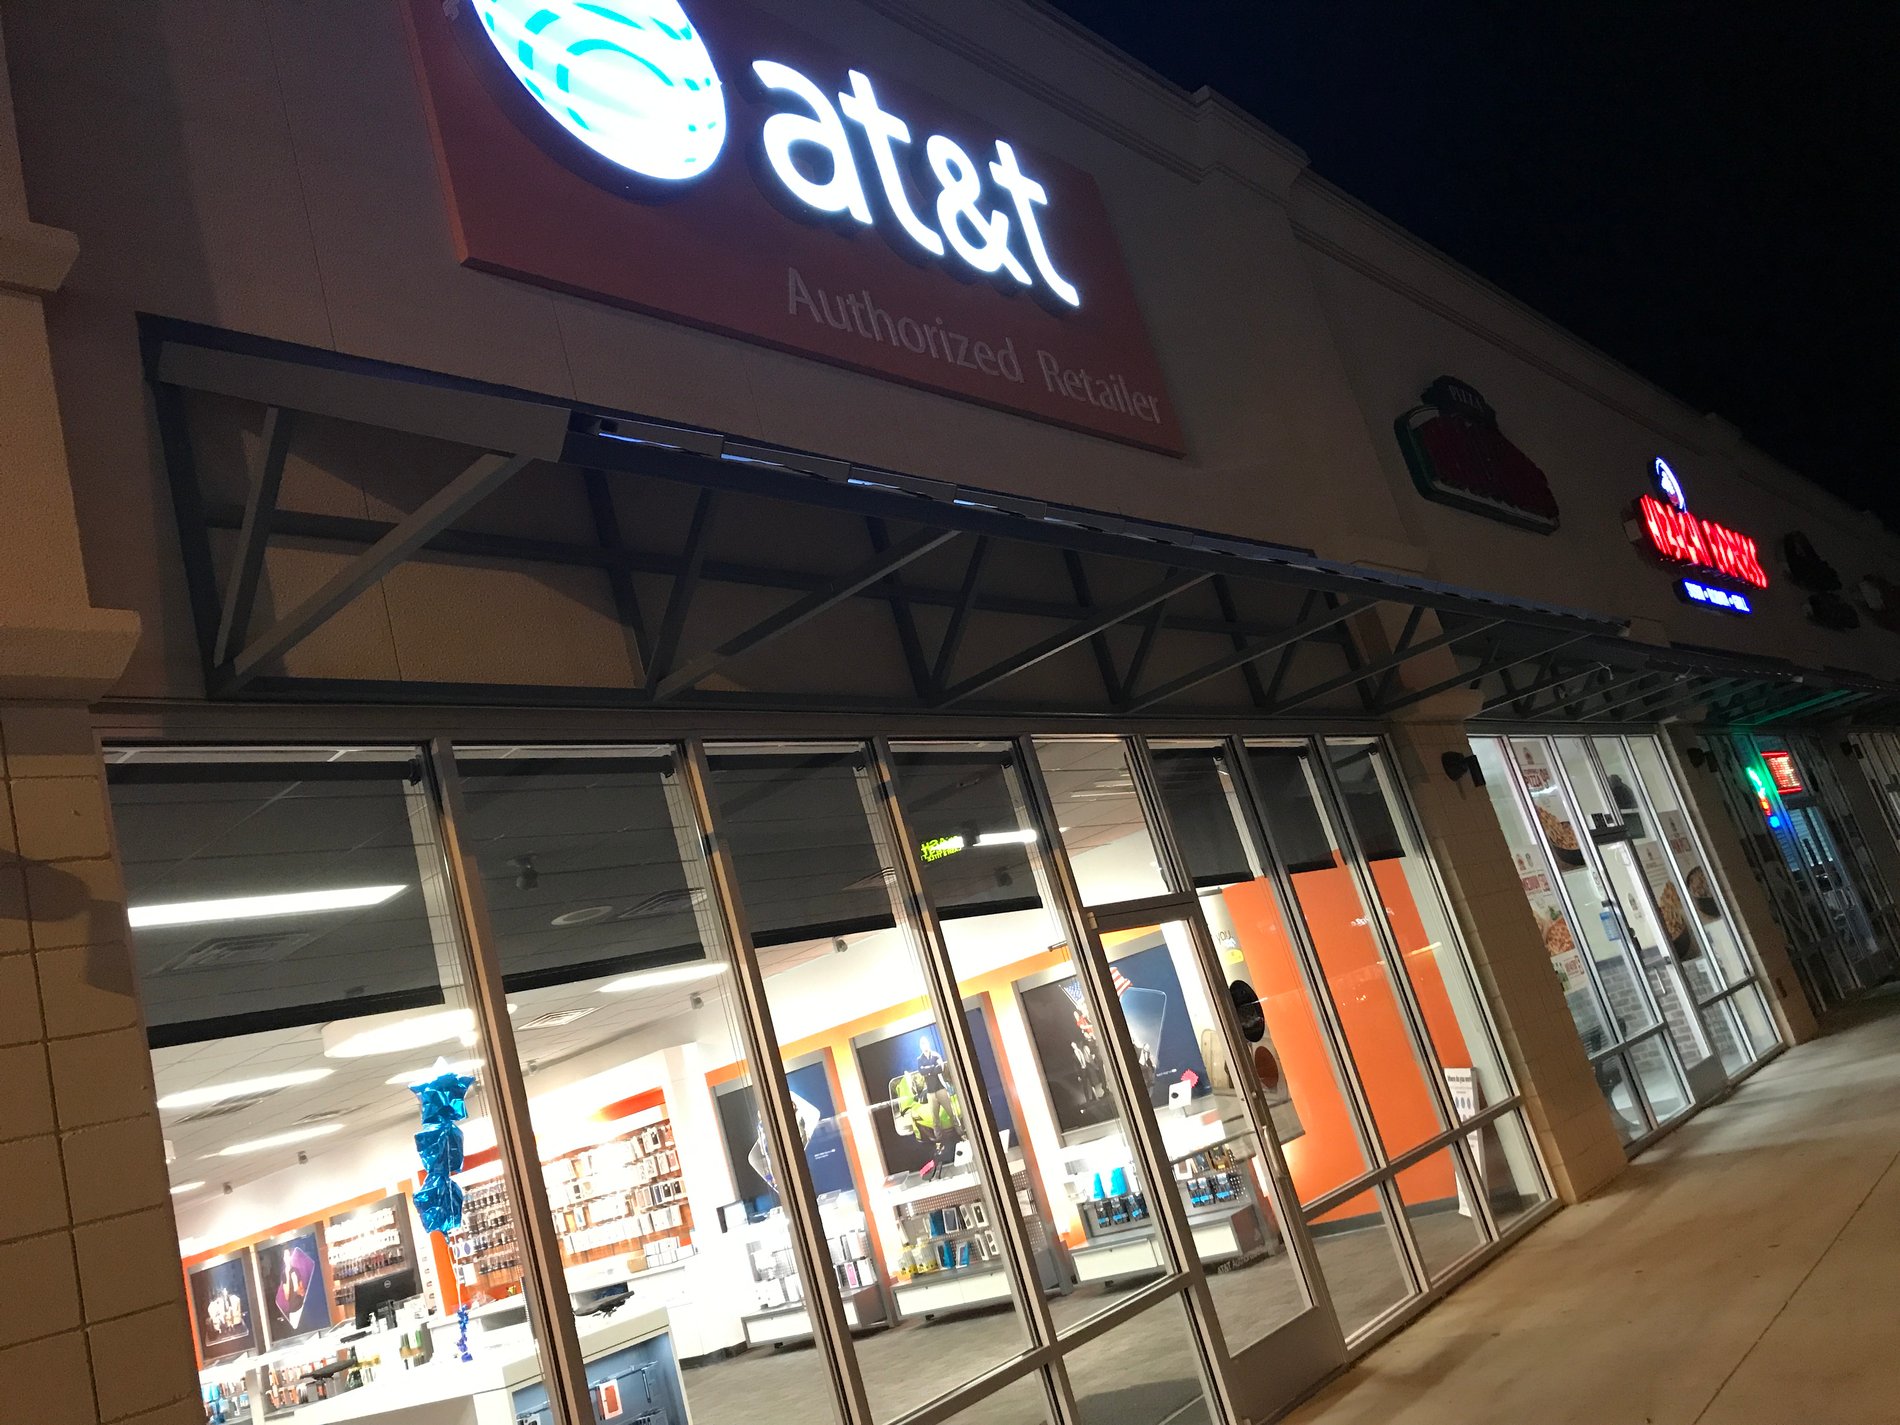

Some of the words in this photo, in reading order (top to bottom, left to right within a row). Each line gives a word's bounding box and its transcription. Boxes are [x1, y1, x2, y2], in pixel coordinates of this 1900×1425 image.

[752, 59, 1080, 307] at&t
[787, 266, 1025, 385] Authorized
[1036, 349, 1162, 425] Retailer
